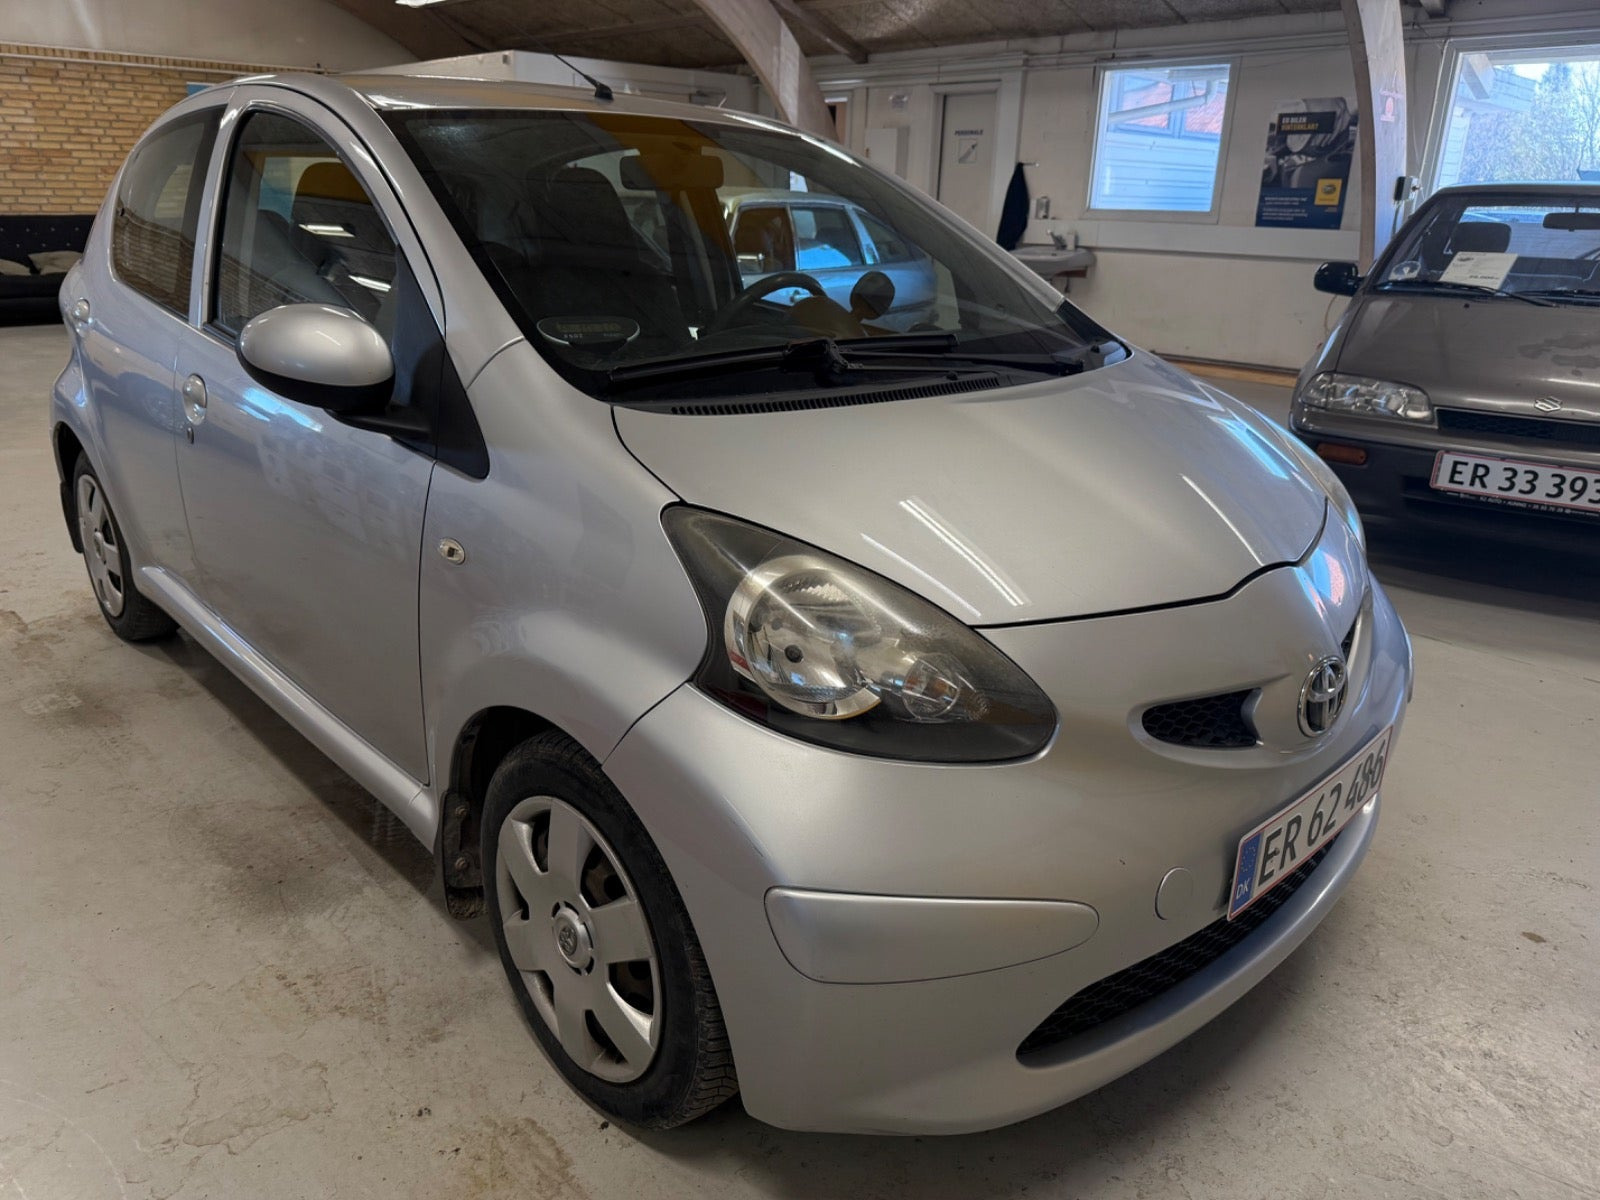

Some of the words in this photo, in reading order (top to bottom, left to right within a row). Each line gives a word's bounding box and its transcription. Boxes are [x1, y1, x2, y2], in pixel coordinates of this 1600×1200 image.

[1449, 460, 1490, 489] ER
[1498, 467, 1539, 495] 33
[1258, 814, 1302, 887] ER
[1307, 782, 1343, 847] 62
[1344, 739, 1386, 811] 486
[1236, 879, 1250, 900] DK
